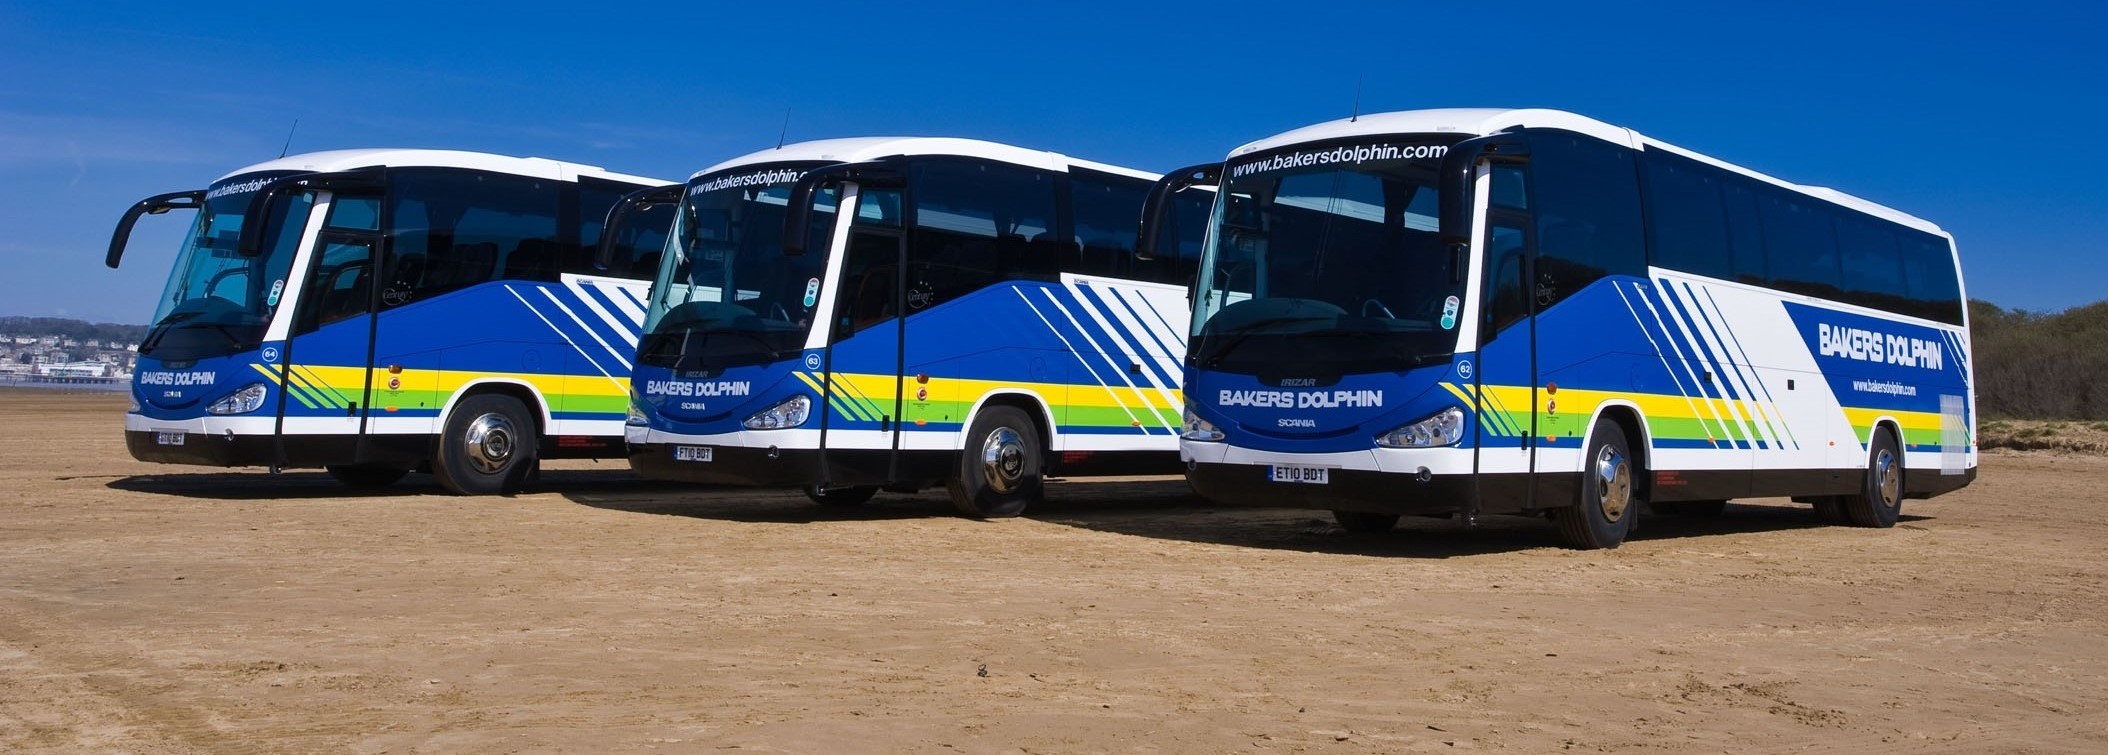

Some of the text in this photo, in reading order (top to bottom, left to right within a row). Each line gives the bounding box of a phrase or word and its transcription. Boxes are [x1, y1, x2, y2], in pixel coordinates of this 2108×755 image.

[1233, 144, 1448, 178] www.bakersdolphin.com
[265, 350, 275, 358] 64
[1819, 323, 1943, 370] BAKERS DOLPHIN
[1460, 365, 1470, 373] 62
[141, 371, 216, 386] BAKERS DOLPHIN
[1280, 378, 1316, 387] IRIZAR
[646, 380, 750, 397] BAKERS DOLPHIN
[1853, 379, 1917, 397] www.bakersdolphin.com
[1219, 389, 1383, 409] BAKERS DOLPHIN
[1277, 418, 1316, 428] SCANIA
[1276, 466, 1325, 481] ET10 BDT
